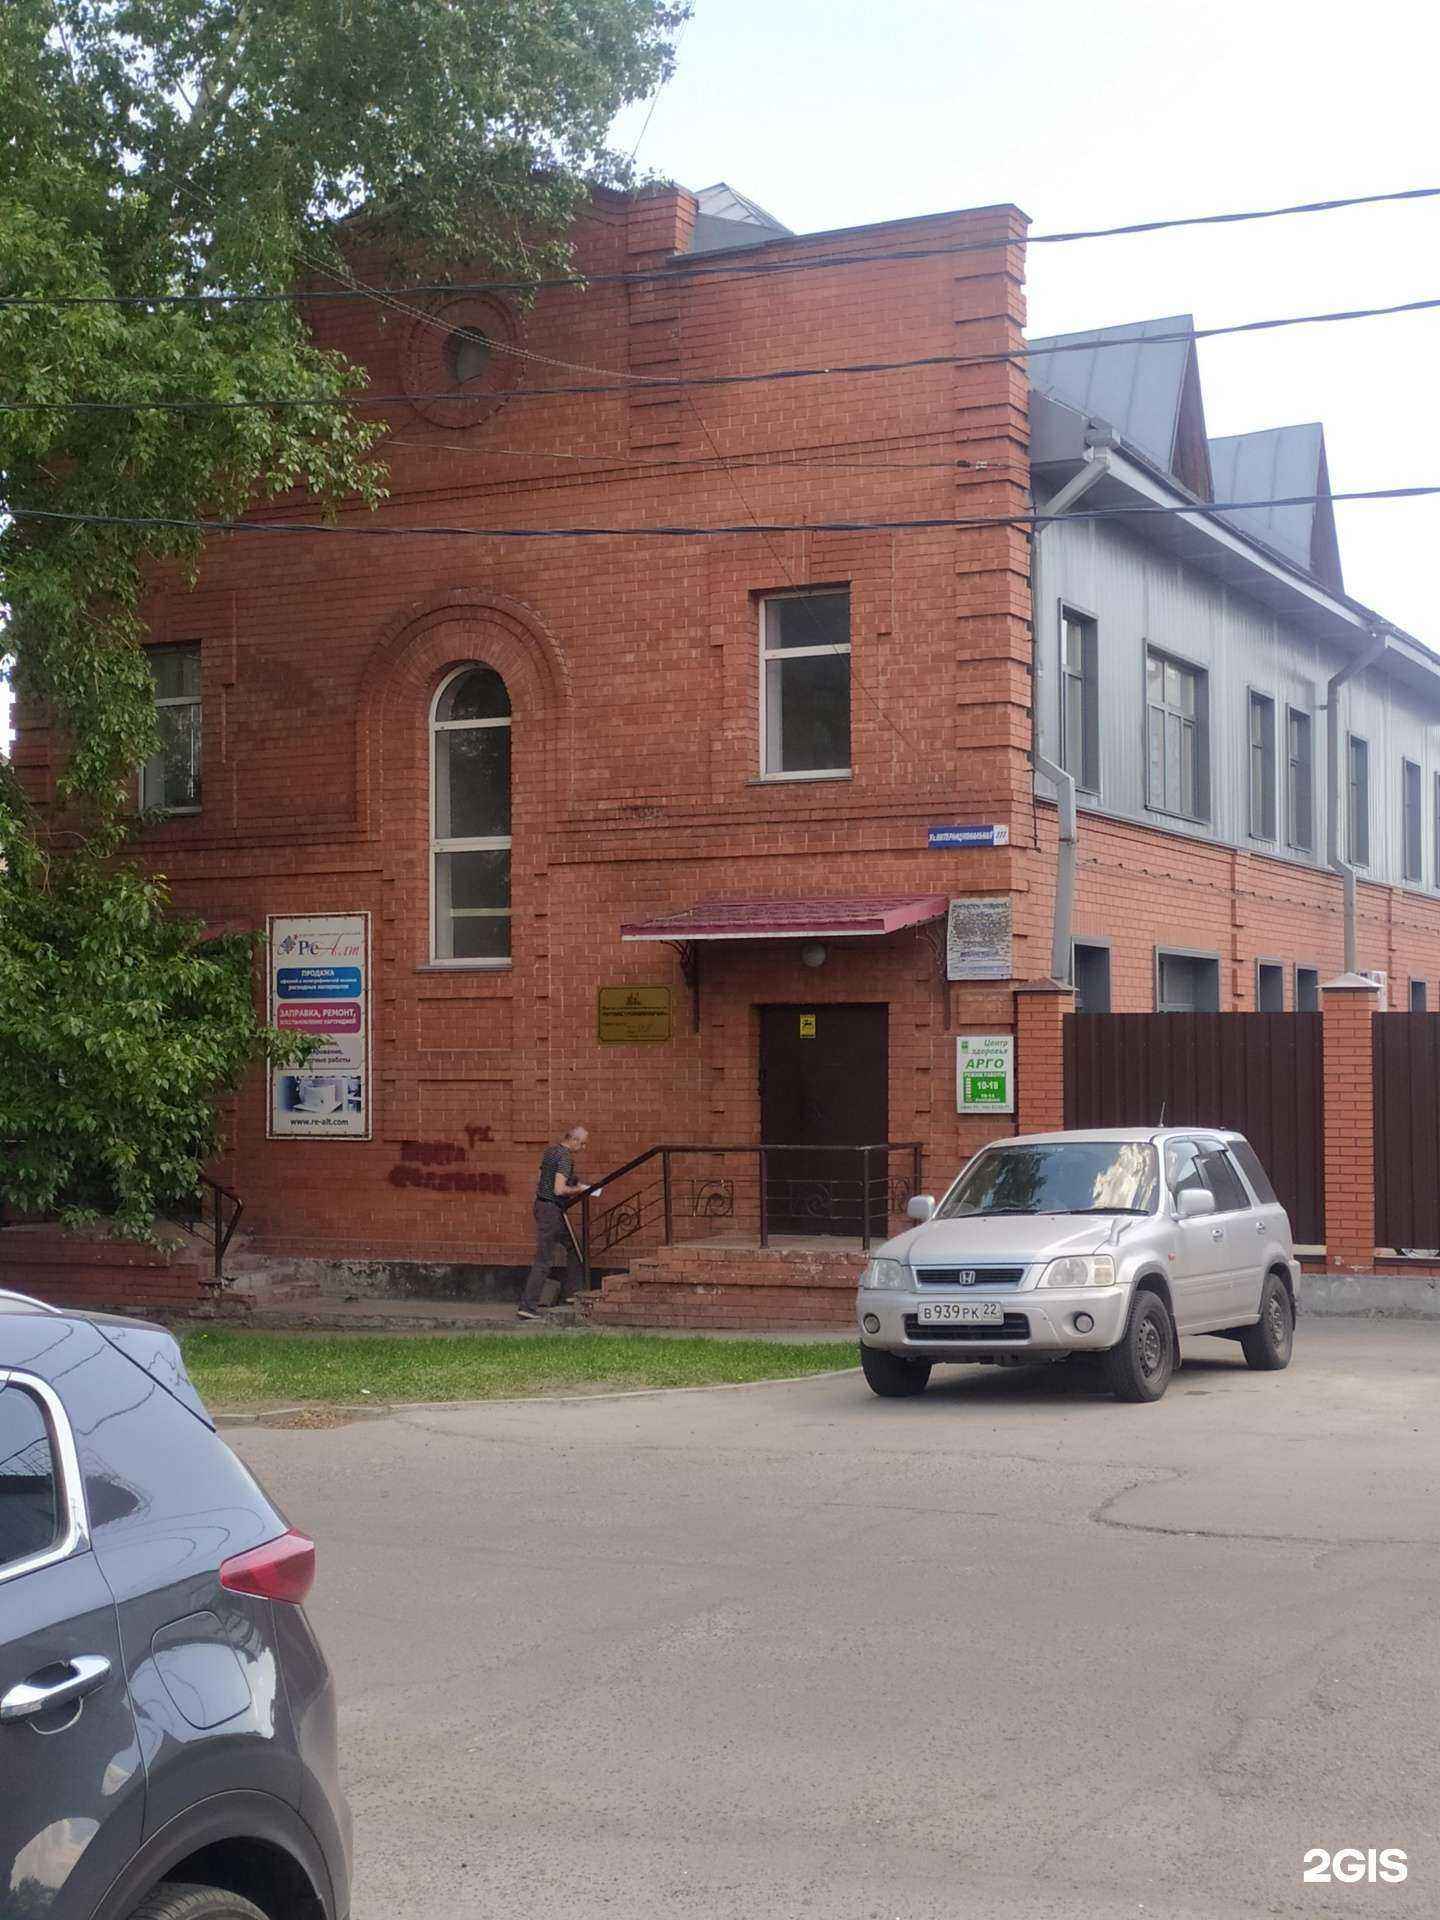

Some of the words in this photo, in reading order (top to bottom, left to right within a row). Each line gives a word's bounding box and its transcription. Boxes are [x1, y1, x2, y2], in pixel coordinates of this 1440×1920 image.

[301, 969, 335, 977] ПРОДАЖА
[280, 1009, 320, 1018] ЗАПРАВКА,
[322, 1008, 357, 1017] РЕМОНТ,
[965, 1058, 1005, 1069] АРГО
[290, 1118, 350, 1126] www.re-alt.com
